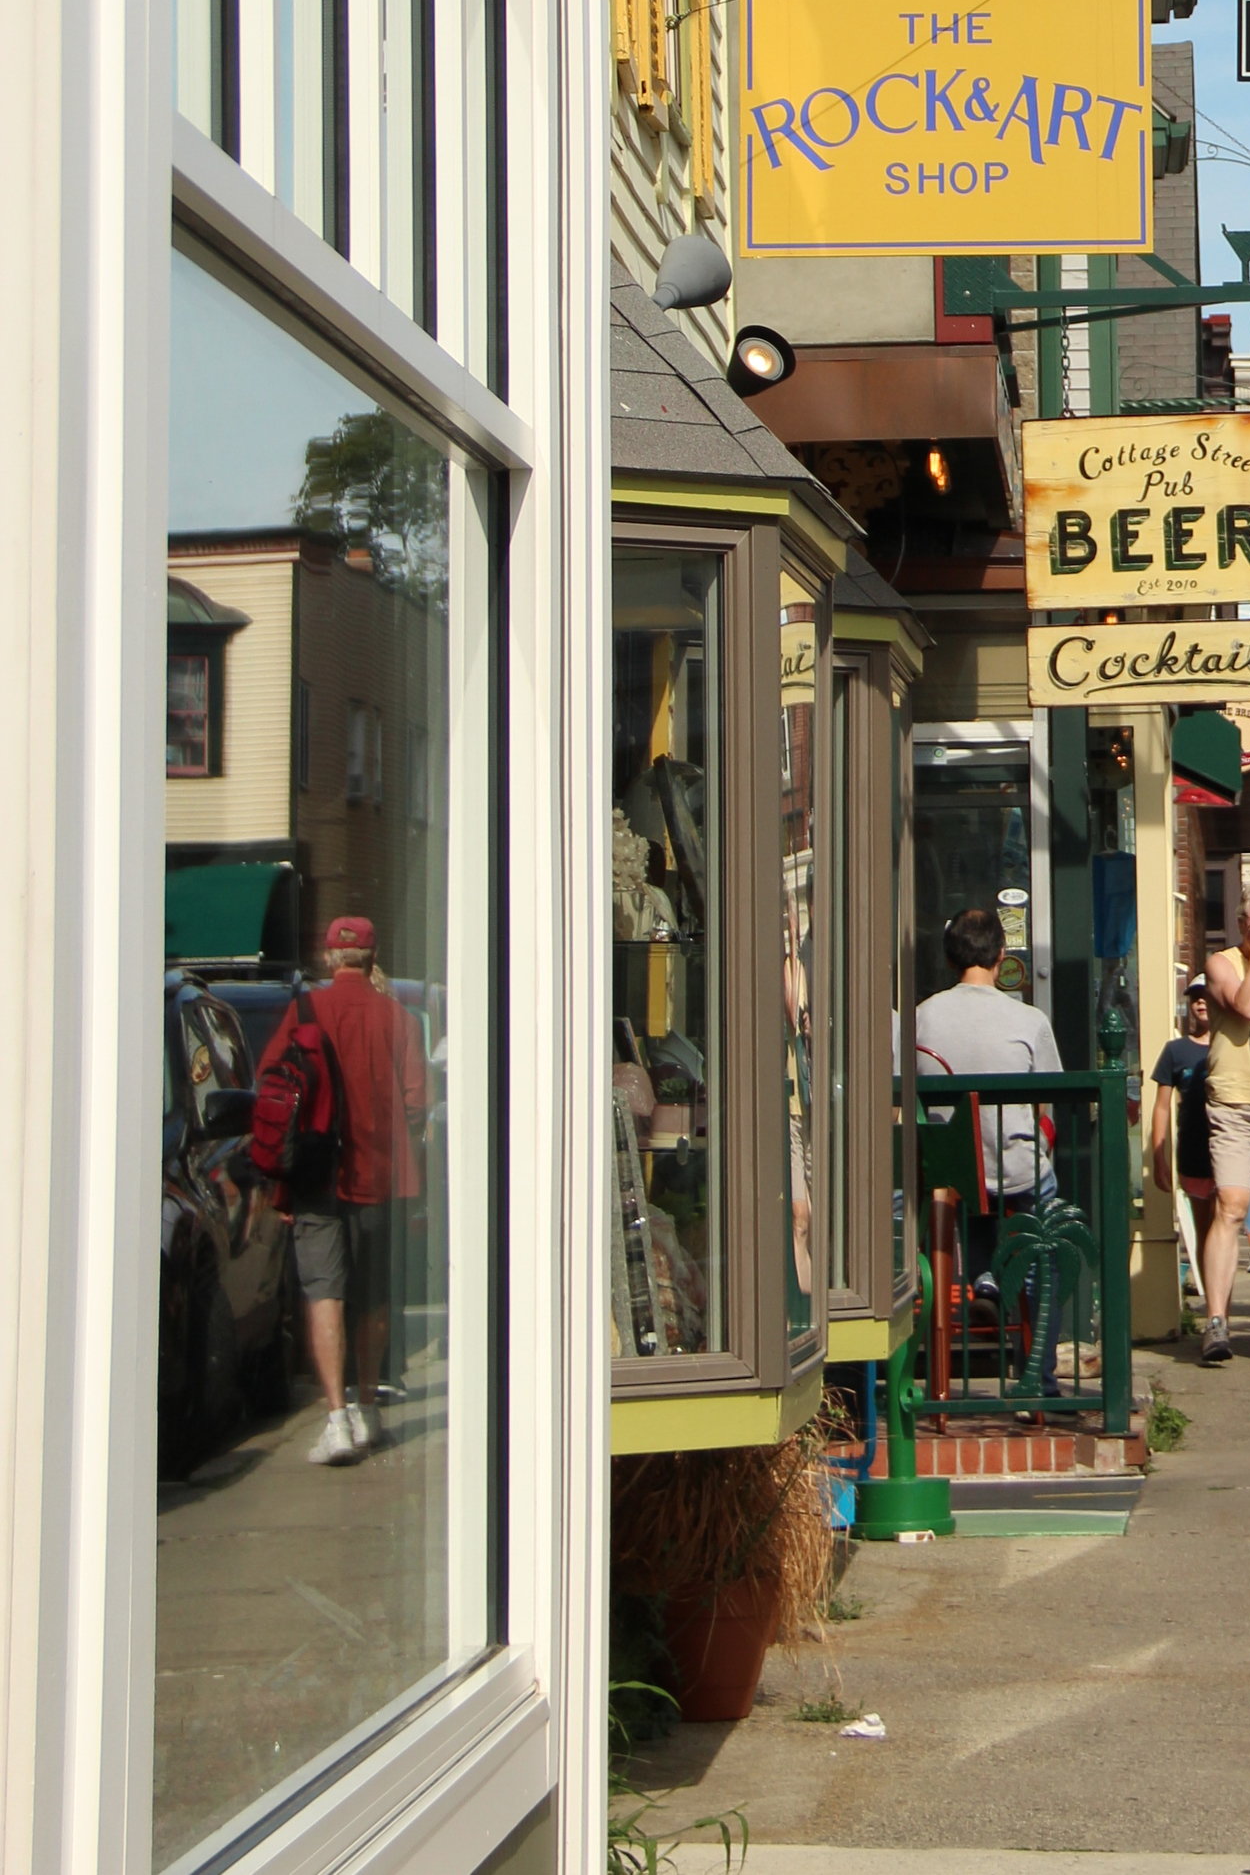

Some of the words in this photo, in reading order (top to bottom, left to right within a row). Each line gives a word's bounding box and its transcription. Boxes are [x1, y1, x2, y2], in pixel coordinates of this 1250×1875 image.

[898, 12, 993, 45] THE
[884, 161, 1010, 195] SHOP
[1078, 442, 1181, 481] Cottage
[1136, 469, 1195, 503] Pub
[1136, 577, 1161, 597] Est
[1166, 579, 1199, 592] 2010
